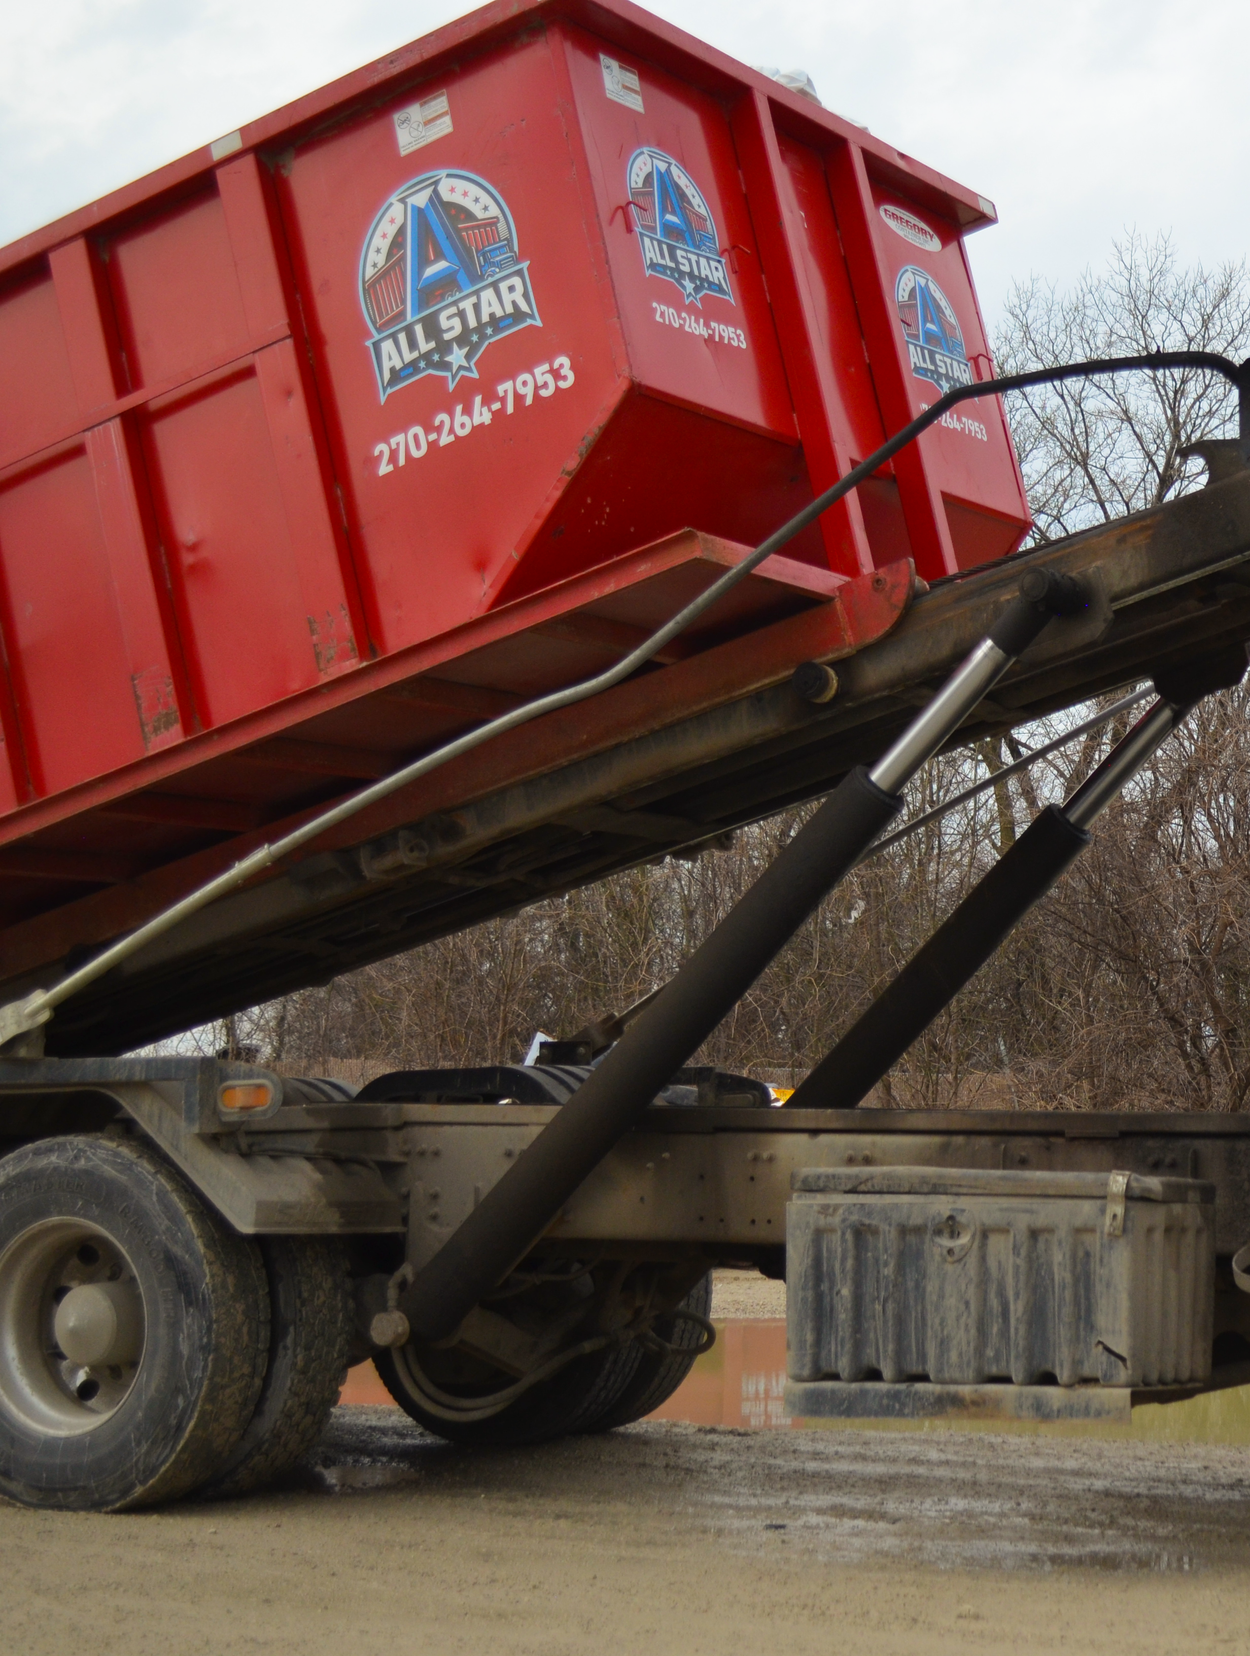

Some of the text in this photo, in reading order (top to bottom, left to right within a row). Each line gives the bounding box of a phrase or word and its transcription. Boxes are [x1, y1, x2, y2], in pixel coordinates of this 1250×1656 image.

[884, 207, 935, 242] GREGORY
[643, 237, 730, 294] ALL STAR
[380, 276, 532, 387] ALL STAR
[652, 302, 747, 349] 270-264-7953
[908, 343, 973, 386] ALL STAR
[374, 356, 575, 477] 270-264-7953
